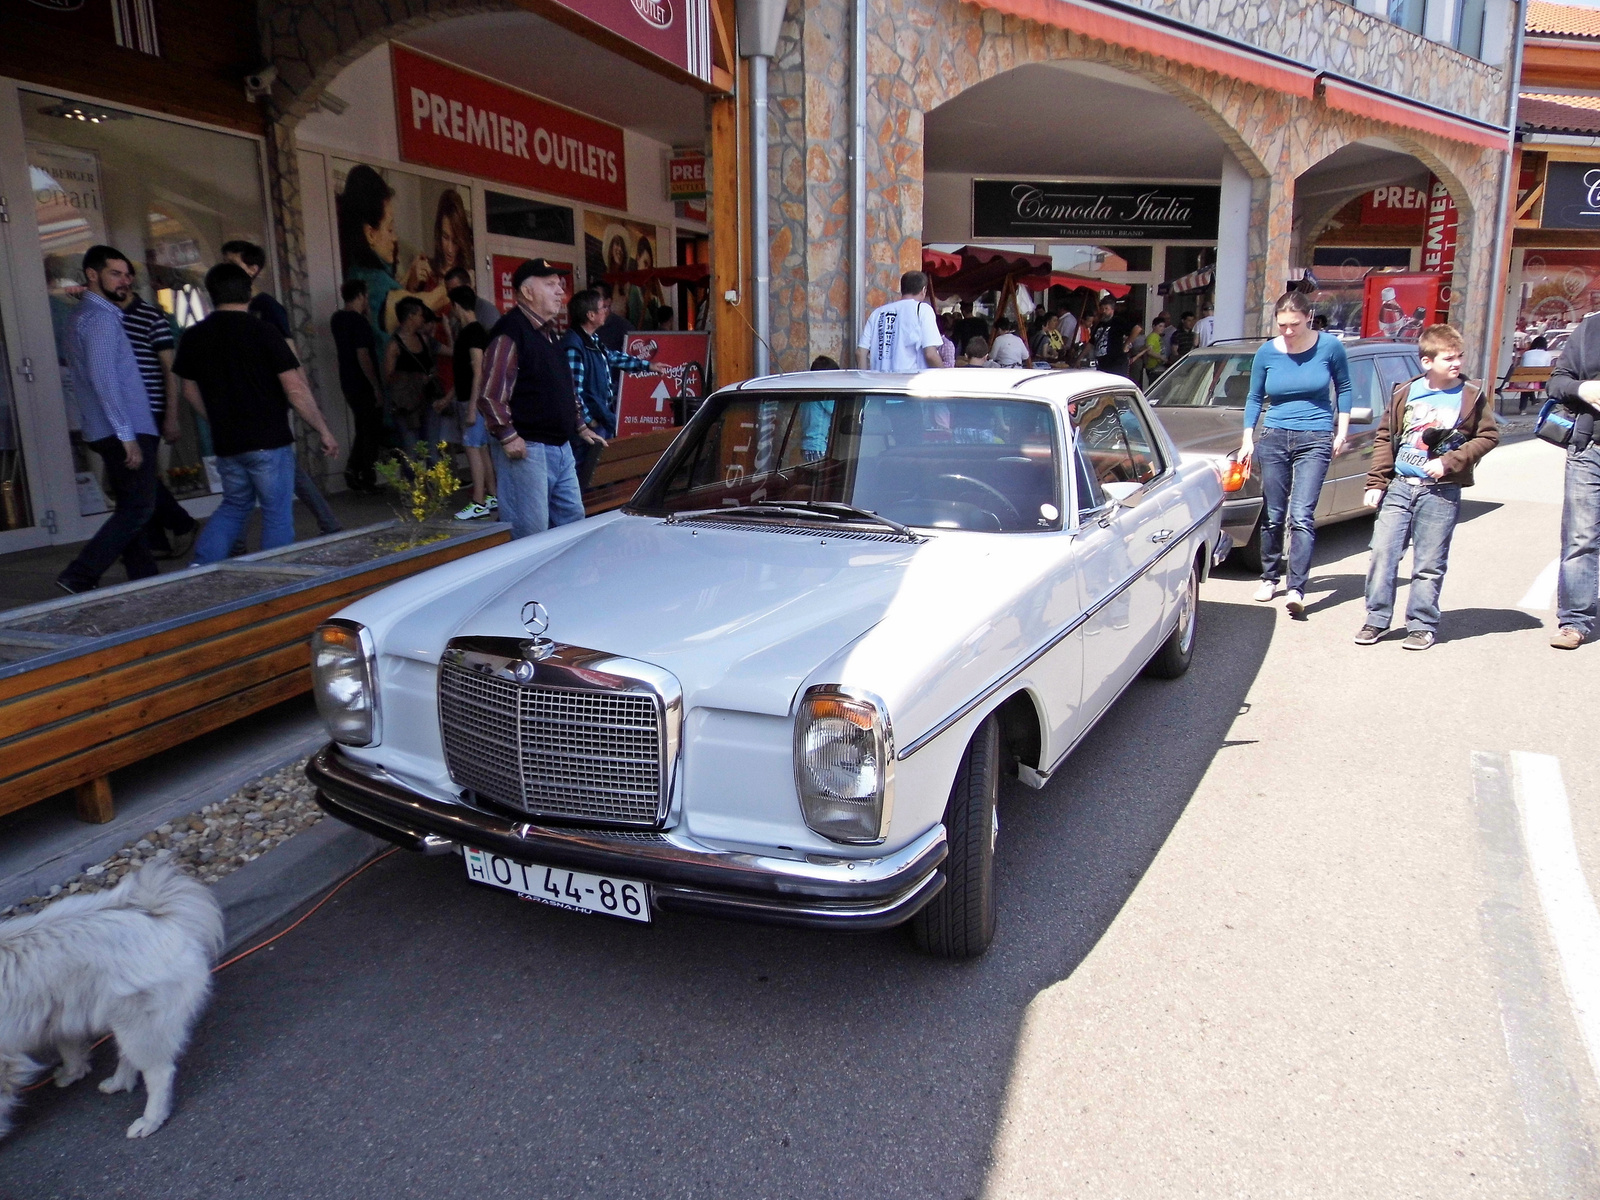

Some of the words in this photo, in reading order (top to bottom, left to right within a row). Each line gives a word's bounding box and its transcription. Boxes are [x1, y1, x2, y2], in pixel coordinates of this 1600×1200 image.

[410, 86, 530, 160] PREMIER
[534, 127, 618, 184] OUTLETS
[672, 164, 705, 181] PRE
[1010, 184, 1114, 221] Comoda
[1119, 189, 1193, 222] Italia
[471, 863, 484, 879] H
[491, 855, 532, 891] OT
[543, 868, 641, 916] 44-86
